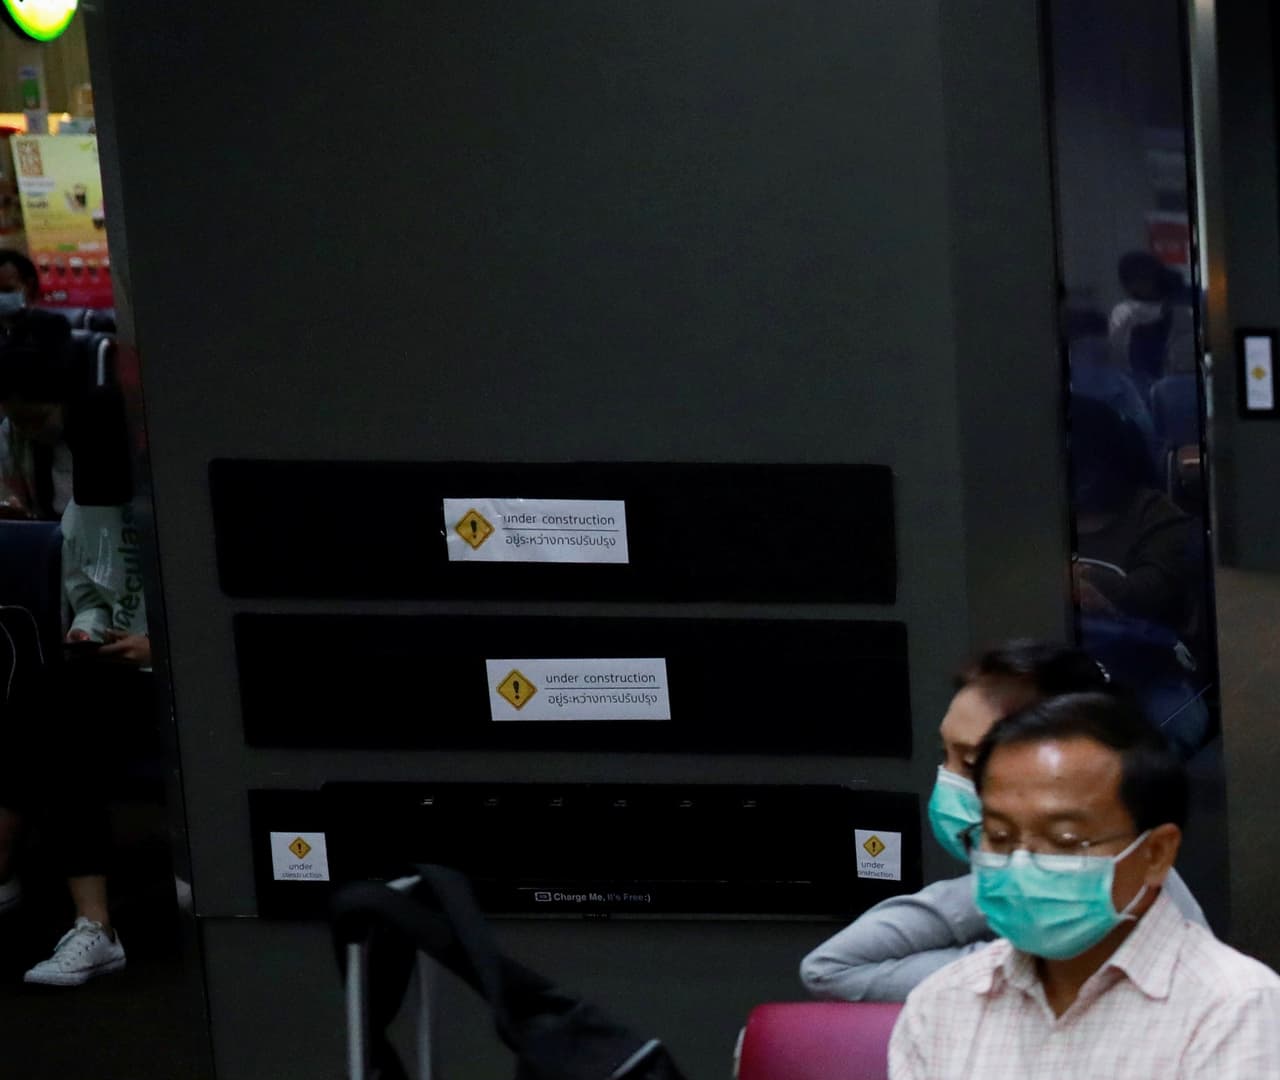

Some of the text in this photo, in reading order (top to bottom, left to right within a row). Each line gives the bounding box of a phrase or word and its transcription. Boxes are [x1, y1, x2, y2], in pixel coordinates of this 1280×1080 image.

[503, 513, 616, 526] under construction
[545, 672, 657, 684] under construction
[553, 892, 587, 903] Charge
